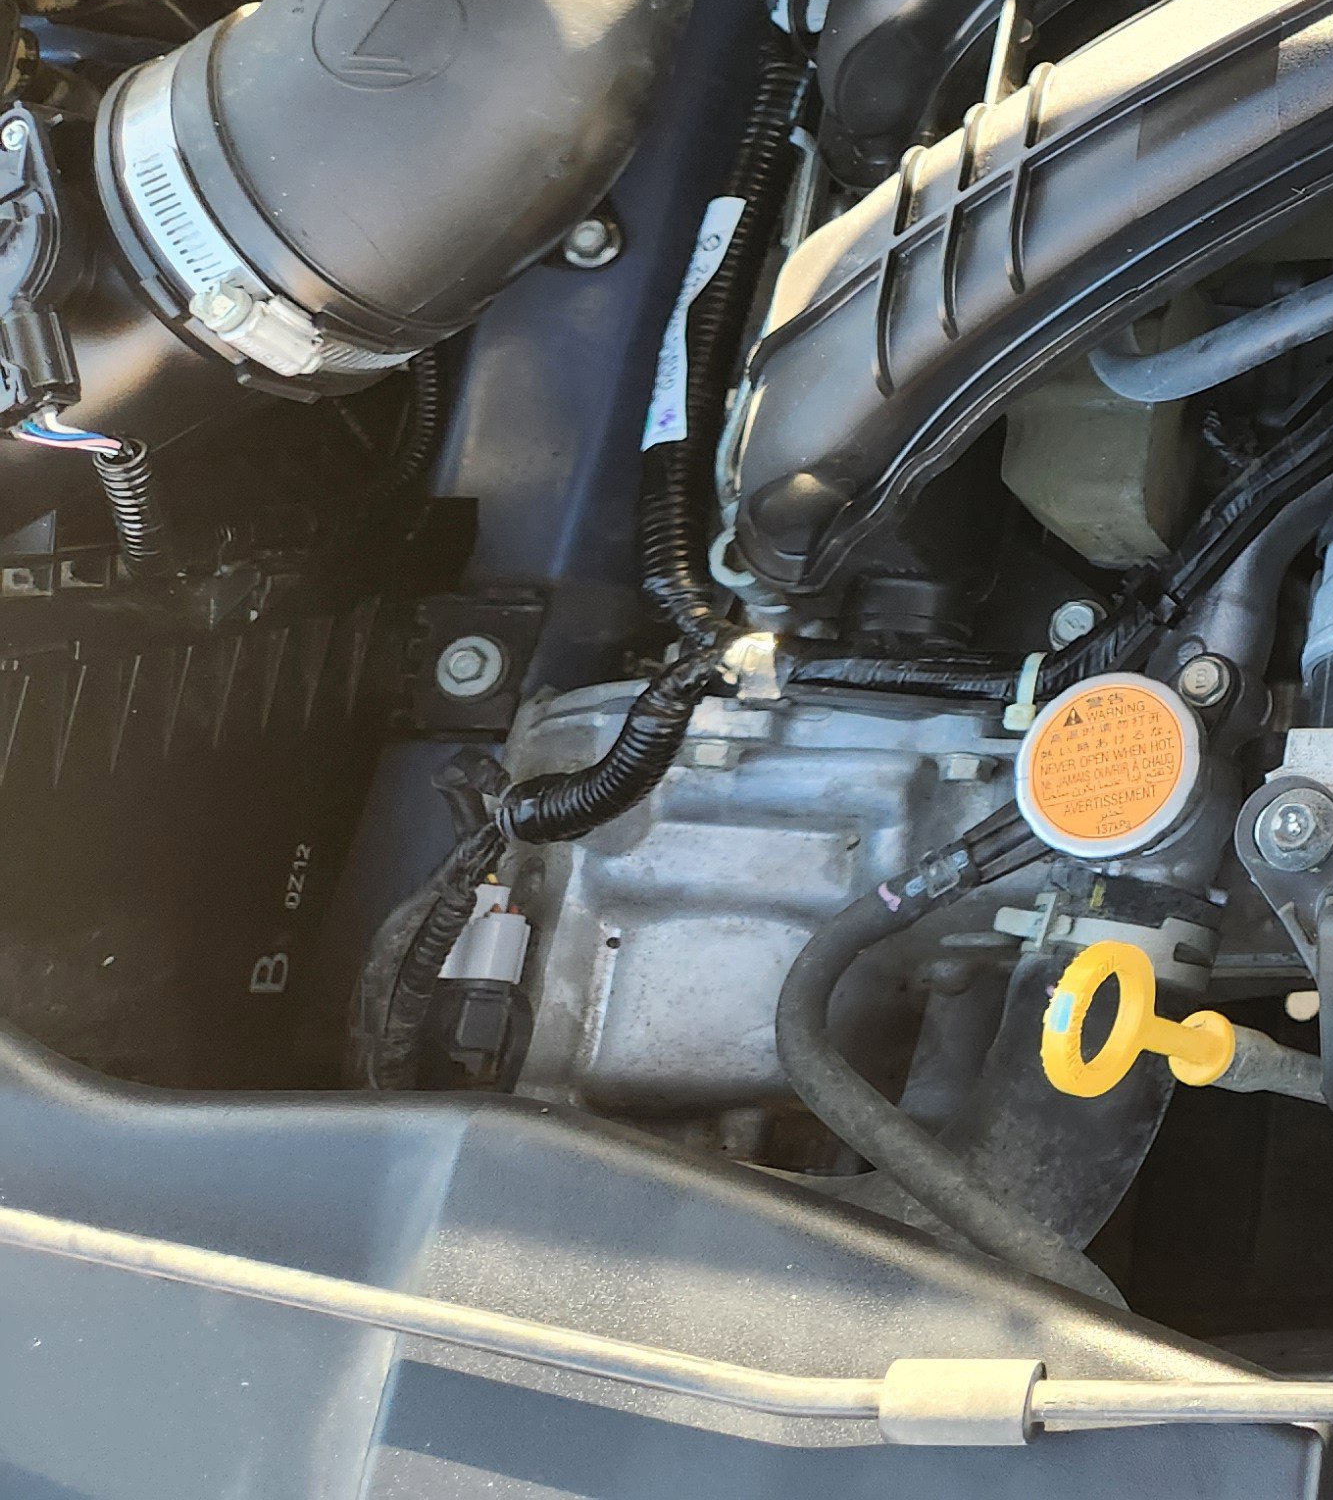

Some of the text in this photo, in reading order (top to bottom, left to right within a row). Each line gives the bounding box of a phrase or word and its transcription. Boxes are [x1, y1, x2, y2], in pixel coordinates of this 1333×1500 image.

[1085, 700, 1146, 723] WARNING
[1040, 737, 1175, 777] NEVER OPEN WHEN HOT.
[1056, 771, 1091, 790] JAMAIS
[1094, 762, 1130, 781] OUVRIR
[1142, 752, 1175, 770] CHAUD
[1063, 784, 1158, 816] AVERTISSEMENT
[250, 951, 289, 994] B
